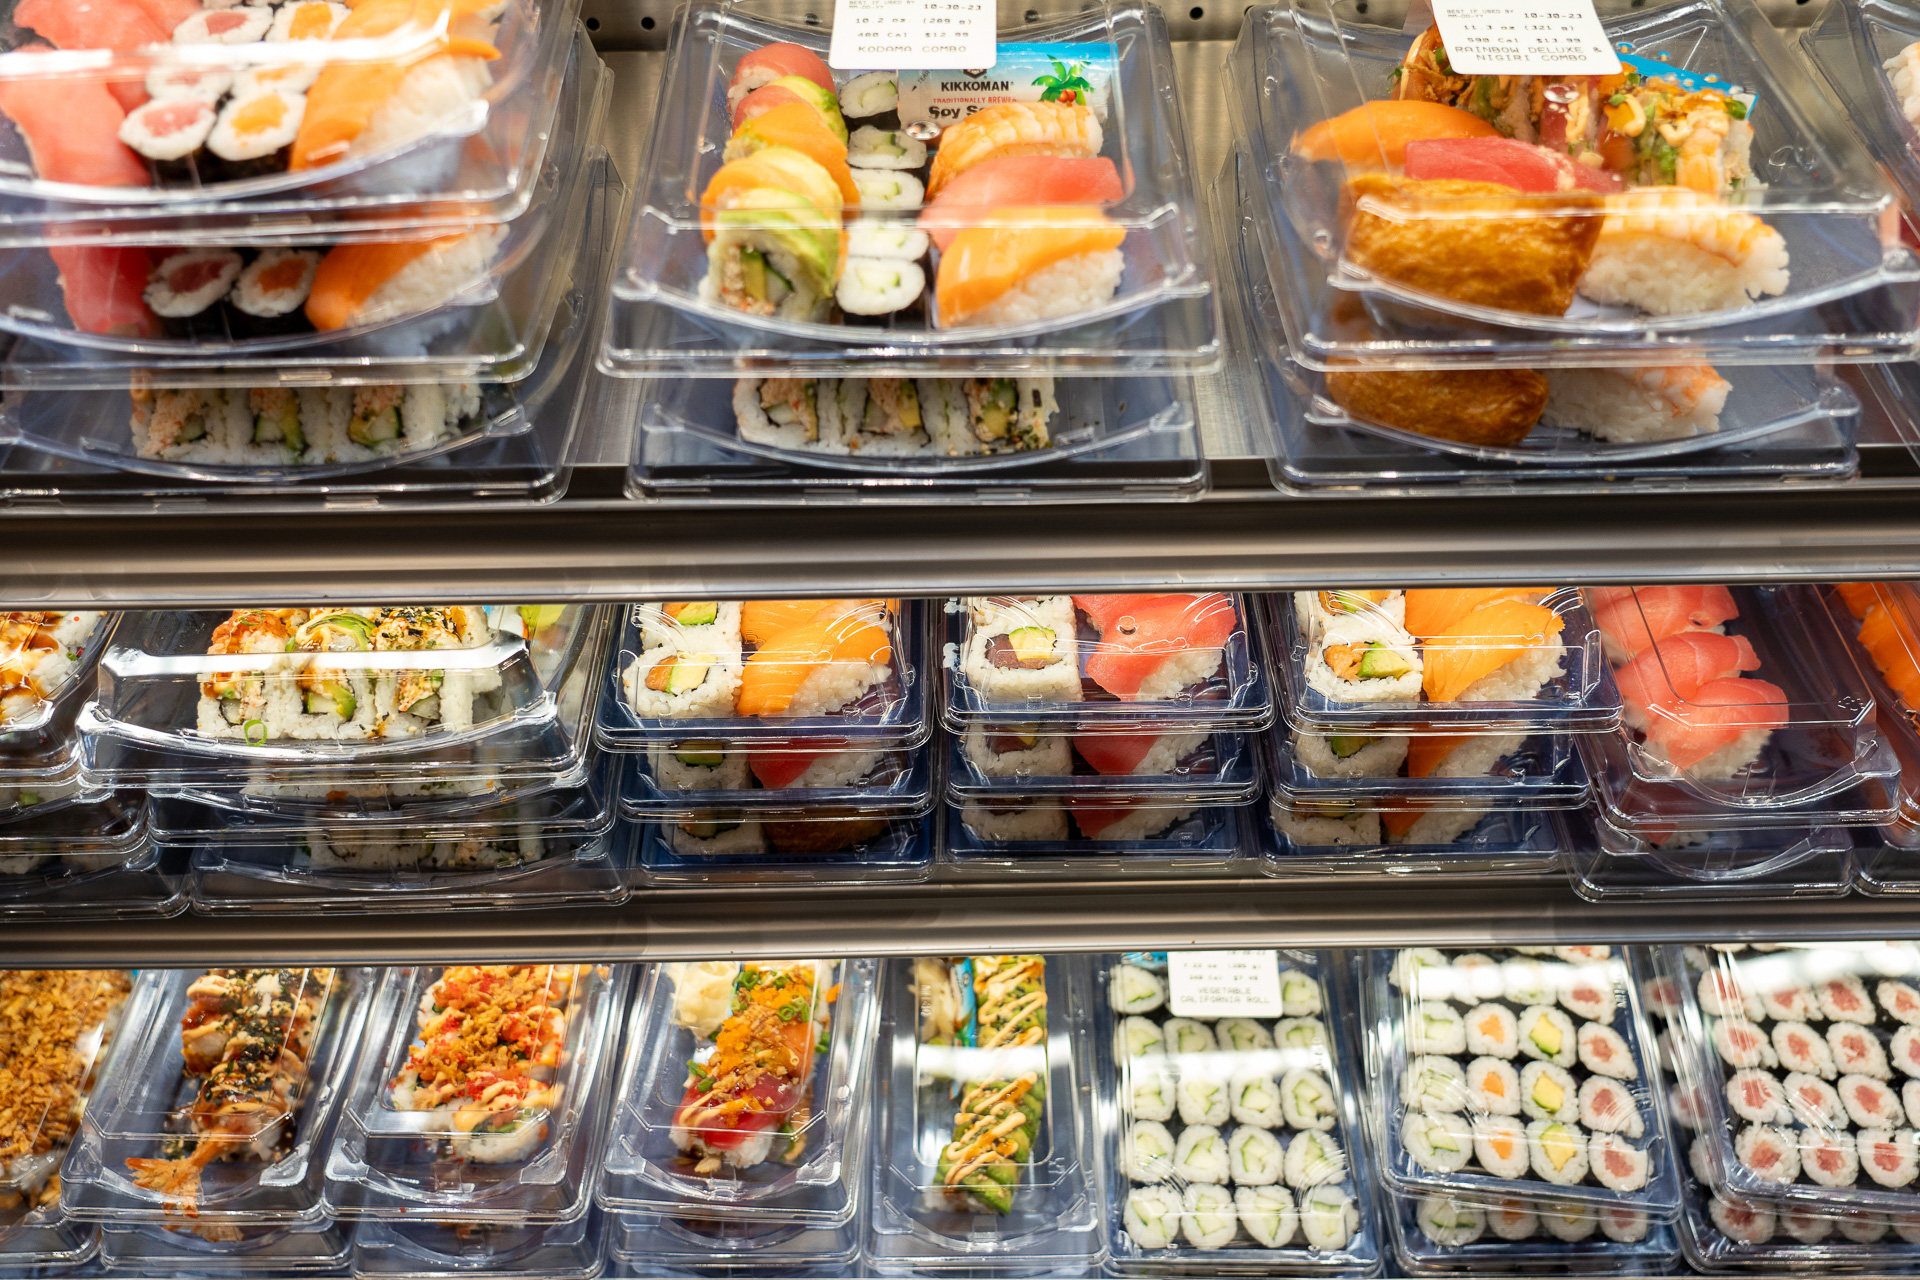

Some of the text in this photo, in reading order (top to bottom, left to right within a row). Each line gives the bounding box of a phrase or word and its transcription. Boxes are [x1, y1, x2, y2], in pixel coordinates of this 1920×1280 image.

[924, 3, 982, 11] 10-30-23
[858, 45, 967, 53] KODAMA COMBO
[1455, 46, 1519, 54] RAINBOW
[1528, 46, 1584, 54] DELUXE
[1476, 54, 1587, 62] NIGIRI COMBO
[941, 80, 1009, 92] KIKKOMAN
[933, 96, 986, 104] TRADITIONALLY
[928, 105, 961, 119] Soy
[1198, 986, 1252, 995] VEGETABLE
[1180, 995, 1271, 1004] CALIFORNIA ROLL
